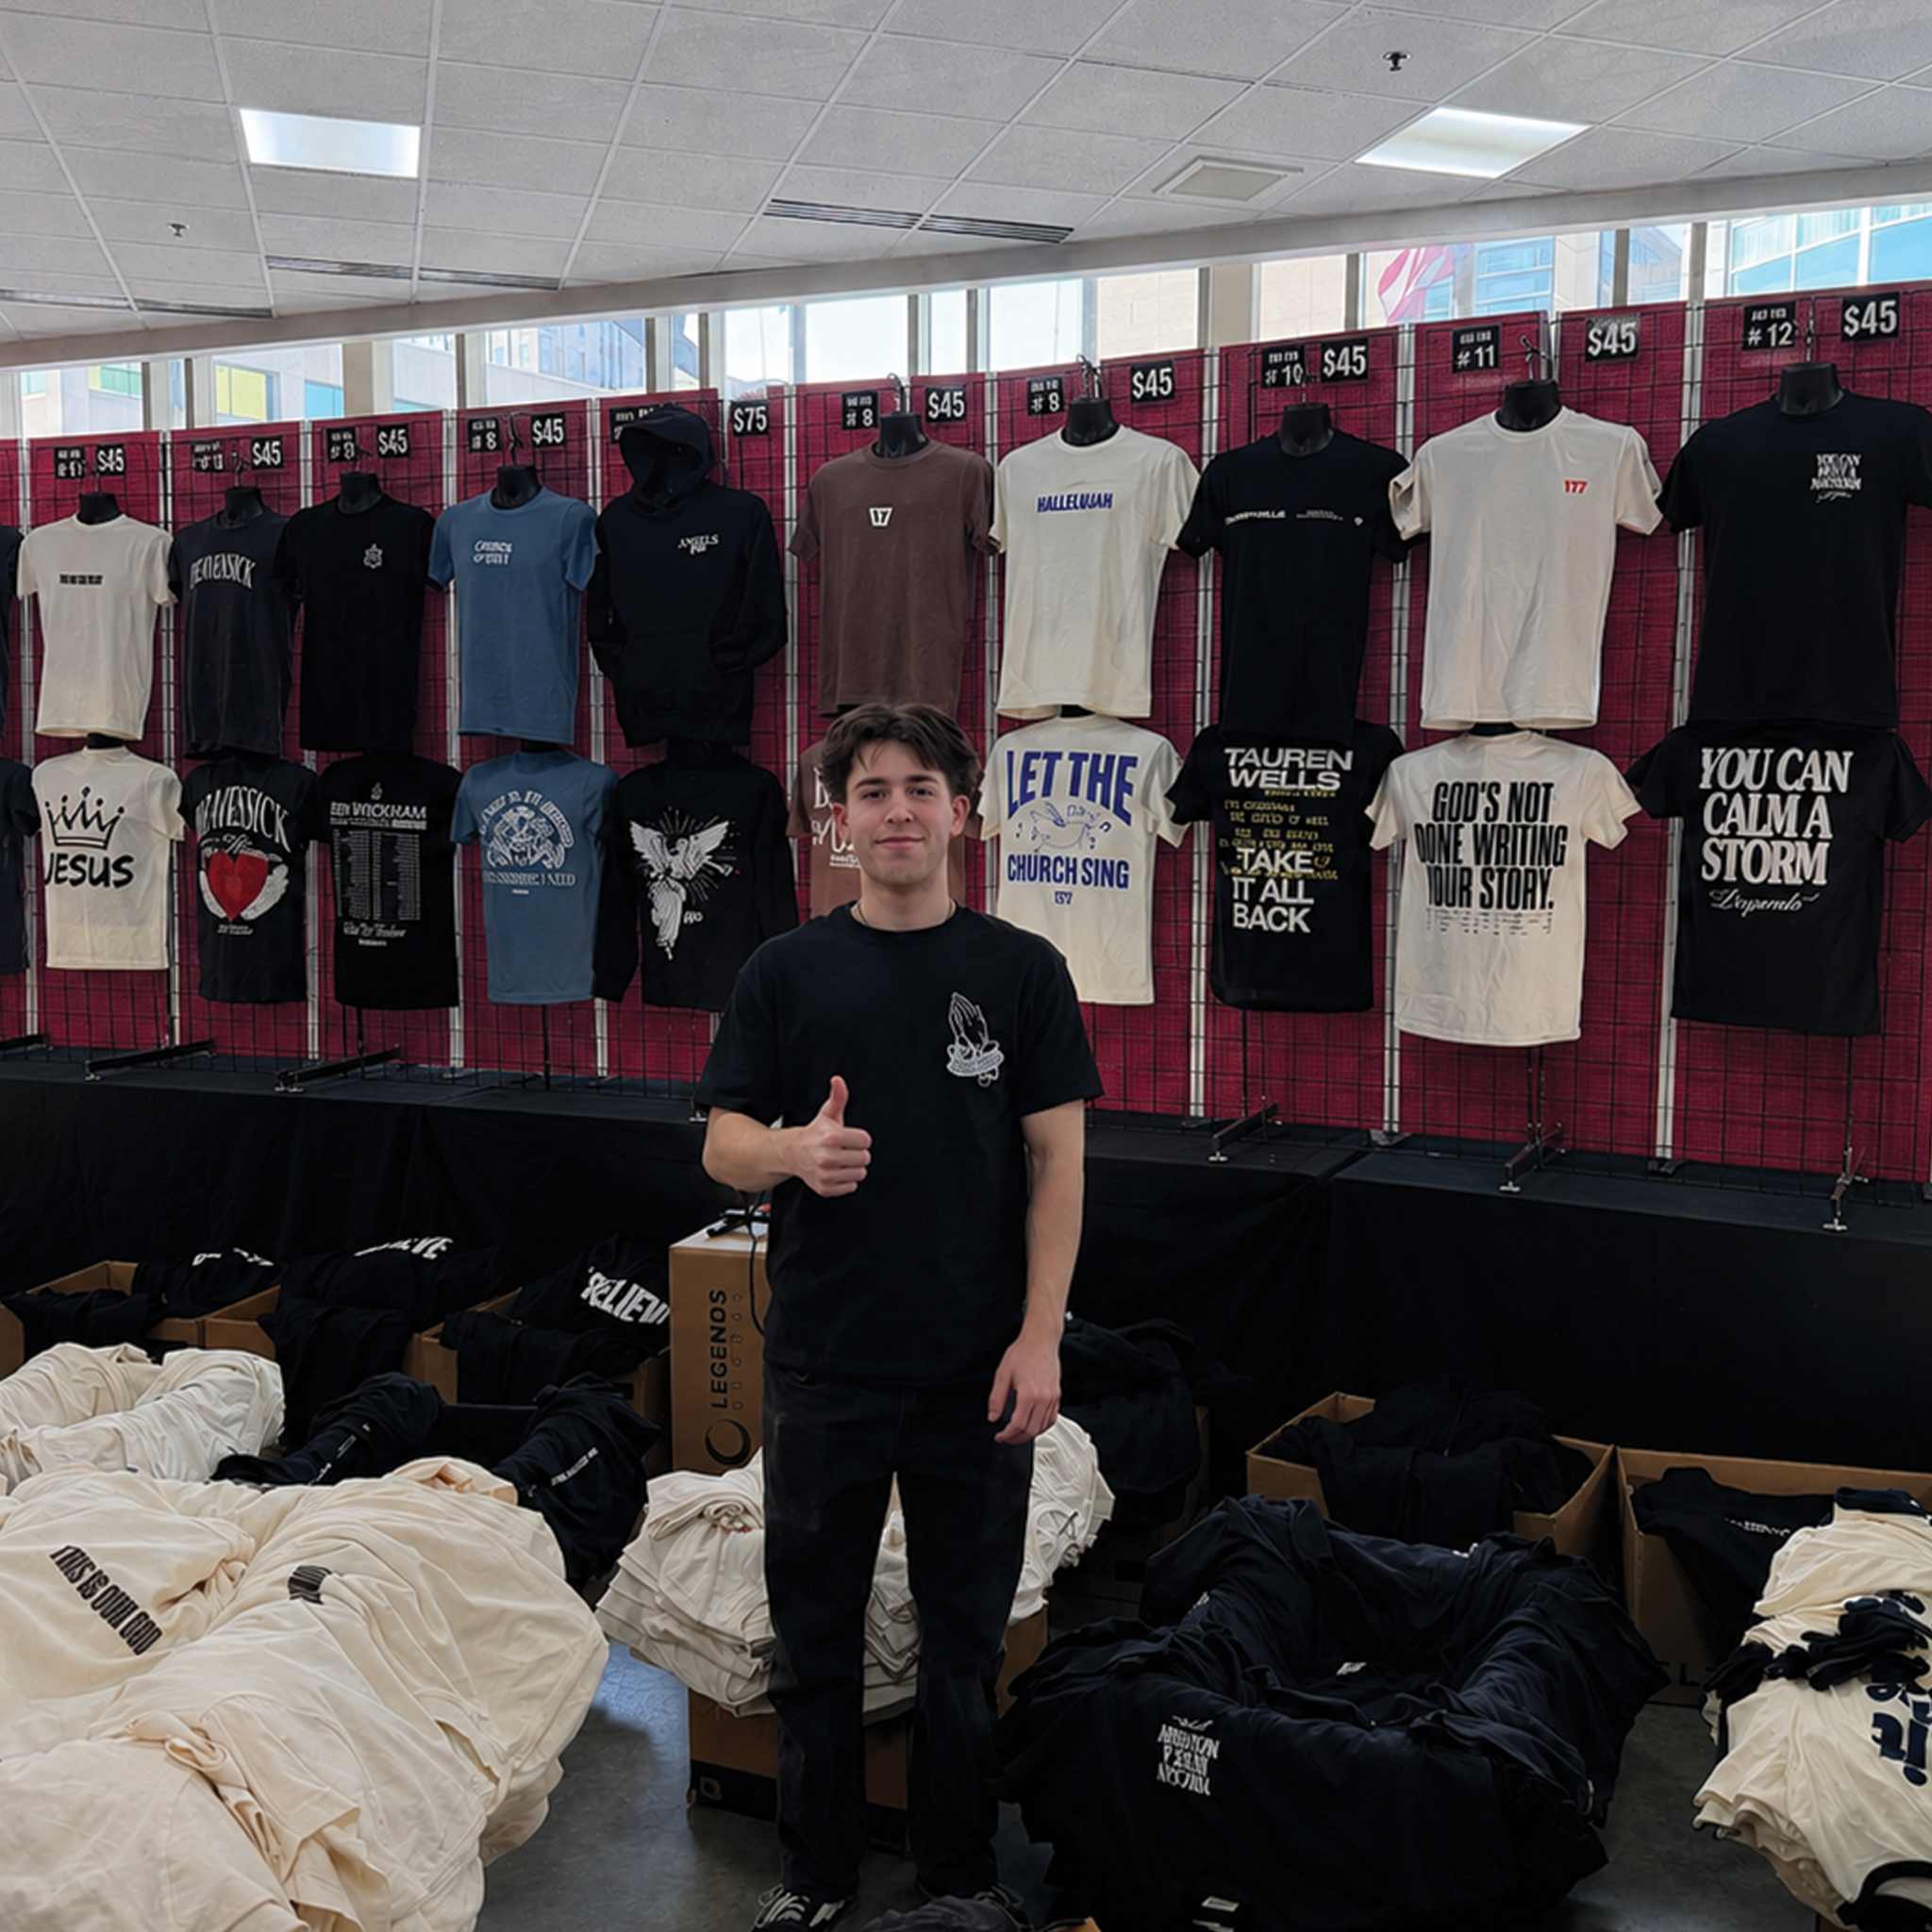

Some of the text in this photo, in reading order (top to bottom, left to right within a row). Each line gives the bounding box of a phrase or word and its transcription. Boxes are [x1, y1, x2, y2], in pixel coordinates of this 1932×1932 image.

[1843, 300, 1897, 337] $45
[1587, 322, 1637, 357] $45
[1323, 344, 1366, 378] $45
[1133, 366, 1173, 399] $45
[734, 406, 768, 433] $75
[927, 391, 966, 419] $45
[378, 428, 408, 456] $45
[533, 418, 564, 444] $45
[97, 448, 125, 473] $45
[252, 441, 282, 467] $45
[1037, 491, 1114, 513] HALLELUJAH
[1224, 746, 1355, 772] TAUREN
[1698, 746, 1855, 793] YOU CAN
[1007, 750, 1064, 822] LET
[1068, 751, 1140, 827] THE
[1228, 768, 1341, 791] WELLS
[1432, 780, 1556, 824] GOD'S NOT
[1703, 791, 1834, 840] CALM A
[1236, 847, 1315, 874] TAKE
[1472, 823, 1569, 868] WRITING
[1701, 837, 1831, 886] STORM
[43, 852, 135, 889] JESUS
[1008, 853, 1130, 890] CHURCH SING
[1232, 875, 1315, 906] IT ALL
[1479, 866, 1556, 910] STORY.
[1232, 902, 1312, 934] BACK
[710, 1289, 728, 1409] LEGENDS
